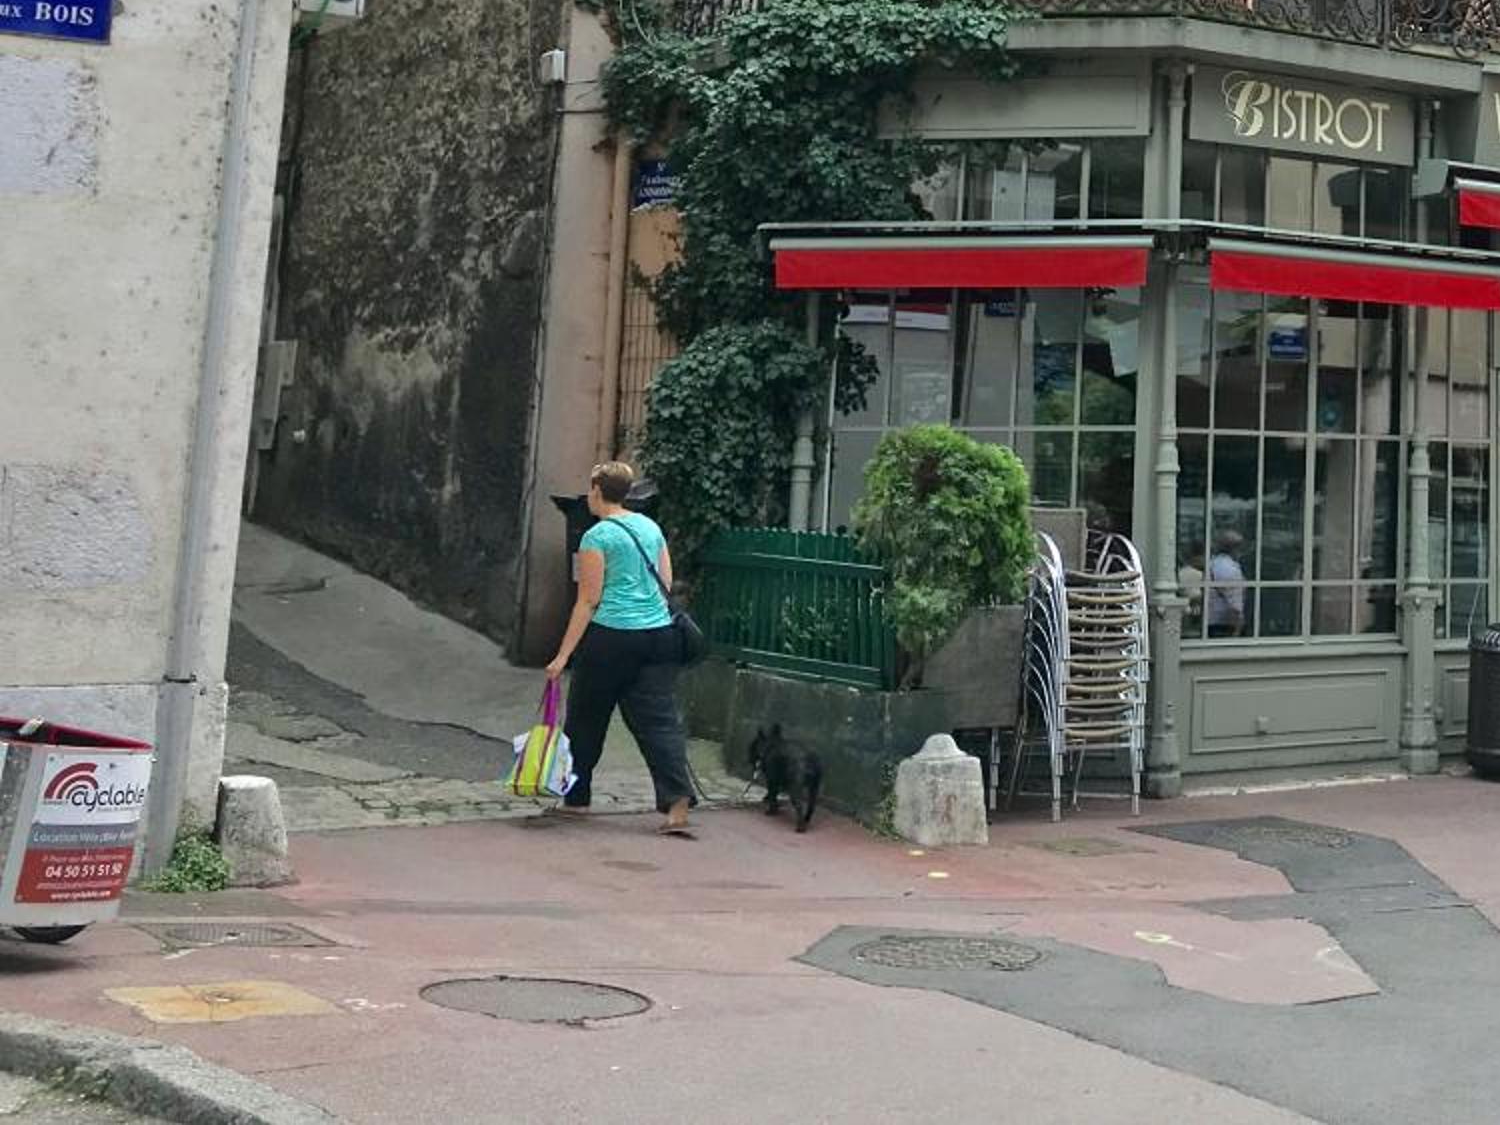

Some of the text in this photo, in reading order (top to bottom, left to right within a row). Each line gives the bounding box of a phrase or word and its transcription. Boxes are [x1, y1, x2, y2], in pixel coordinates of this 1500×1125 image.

[0, 1, 94, 26] ux BOIS
[1222, 70, 1391, 152] BISTROT
[71, 782, 144, 813] cyclable
[45, 866, 62, 878] 04
